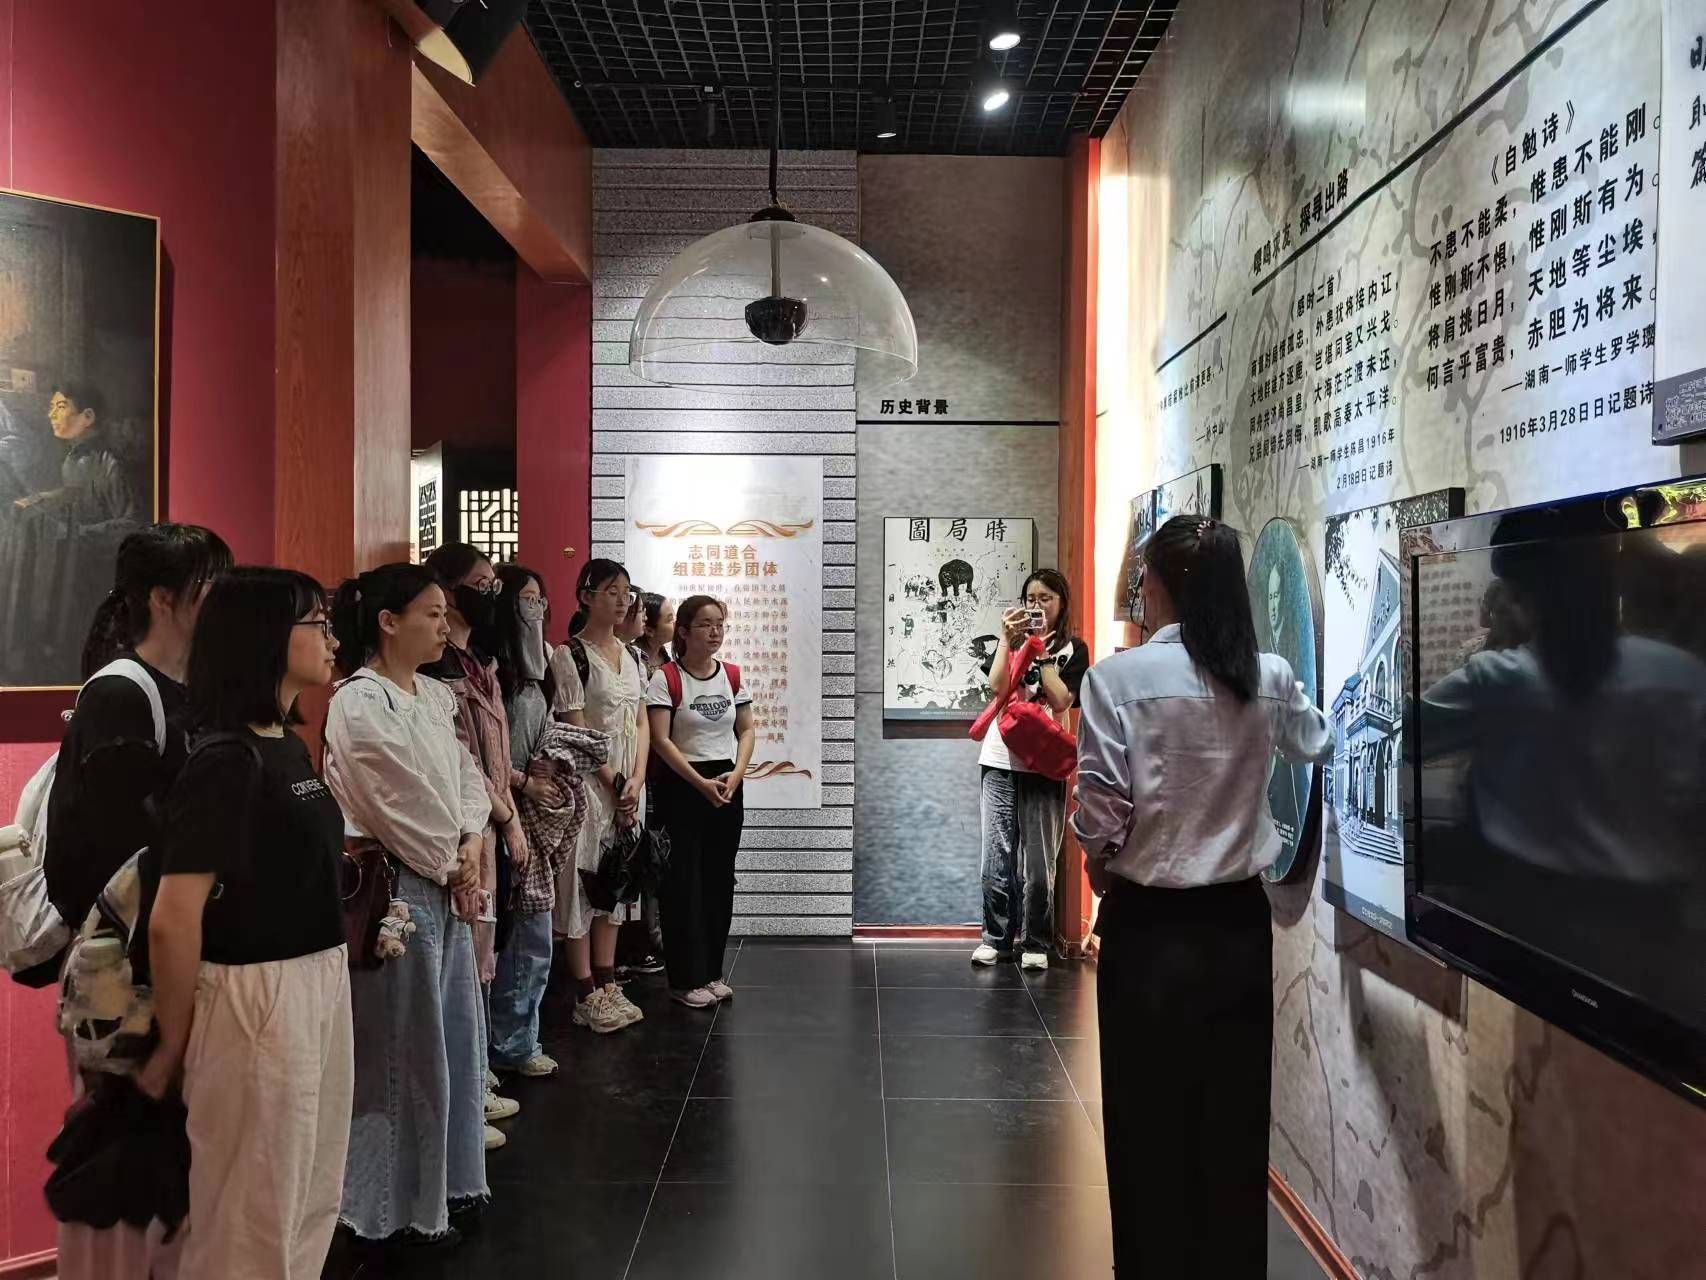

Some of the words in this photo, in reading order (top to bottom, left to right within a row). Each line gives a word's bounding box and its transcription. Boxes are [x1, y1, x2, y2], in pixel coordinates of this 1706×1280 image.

[1491, 100, 1574, 185] 《自勉诗》
[1300, 168, 1348, 236] 探寻出路
[880, 398, 949, 415] 历史背景
[688, 544, 757, 560] 志同道合
[672, 561, 778, 577] 组建进步团体
